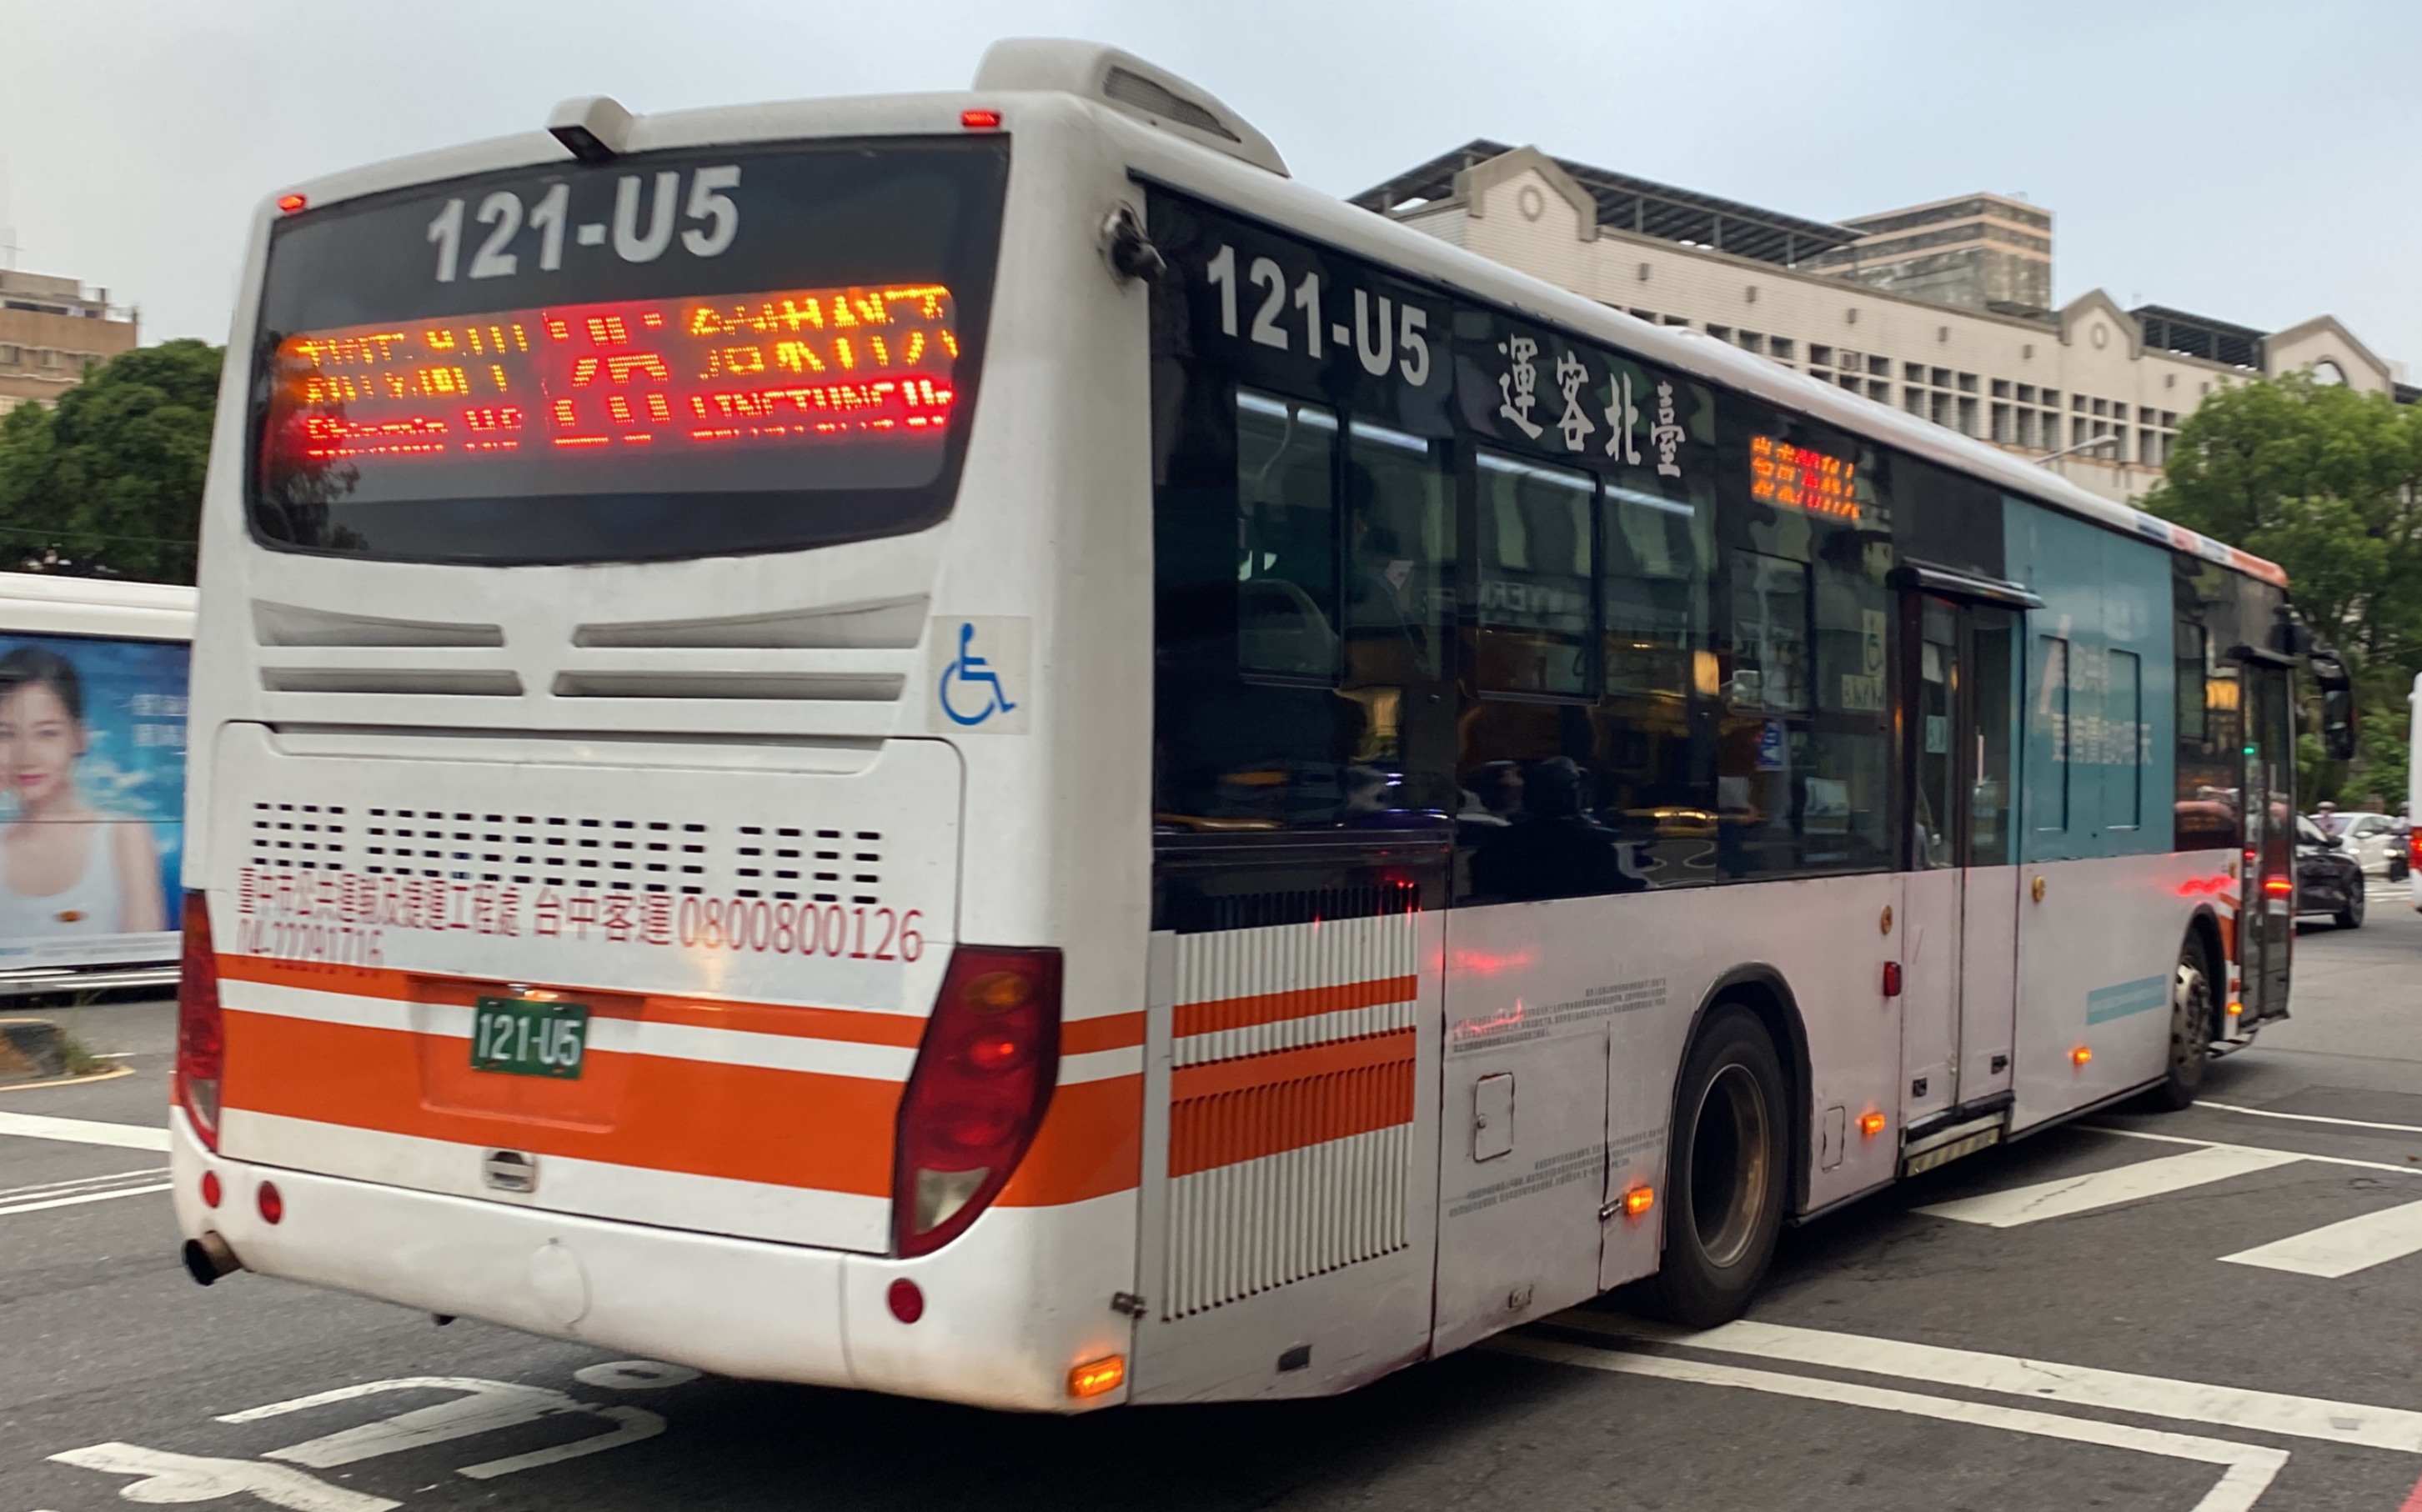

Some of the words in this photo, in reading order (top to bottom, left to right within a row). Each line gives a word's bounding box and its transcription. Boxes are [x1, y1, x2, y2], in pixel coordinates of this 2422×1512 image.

[427, 165, 741, 283] 121-U5
[1206, 243, 1431, 388] 121-U5
[534, 887, 674, 946] 台中客運
[677, 895, 925, 964] 0800800126
[478, 1013, 583, 1067] 121-U5
